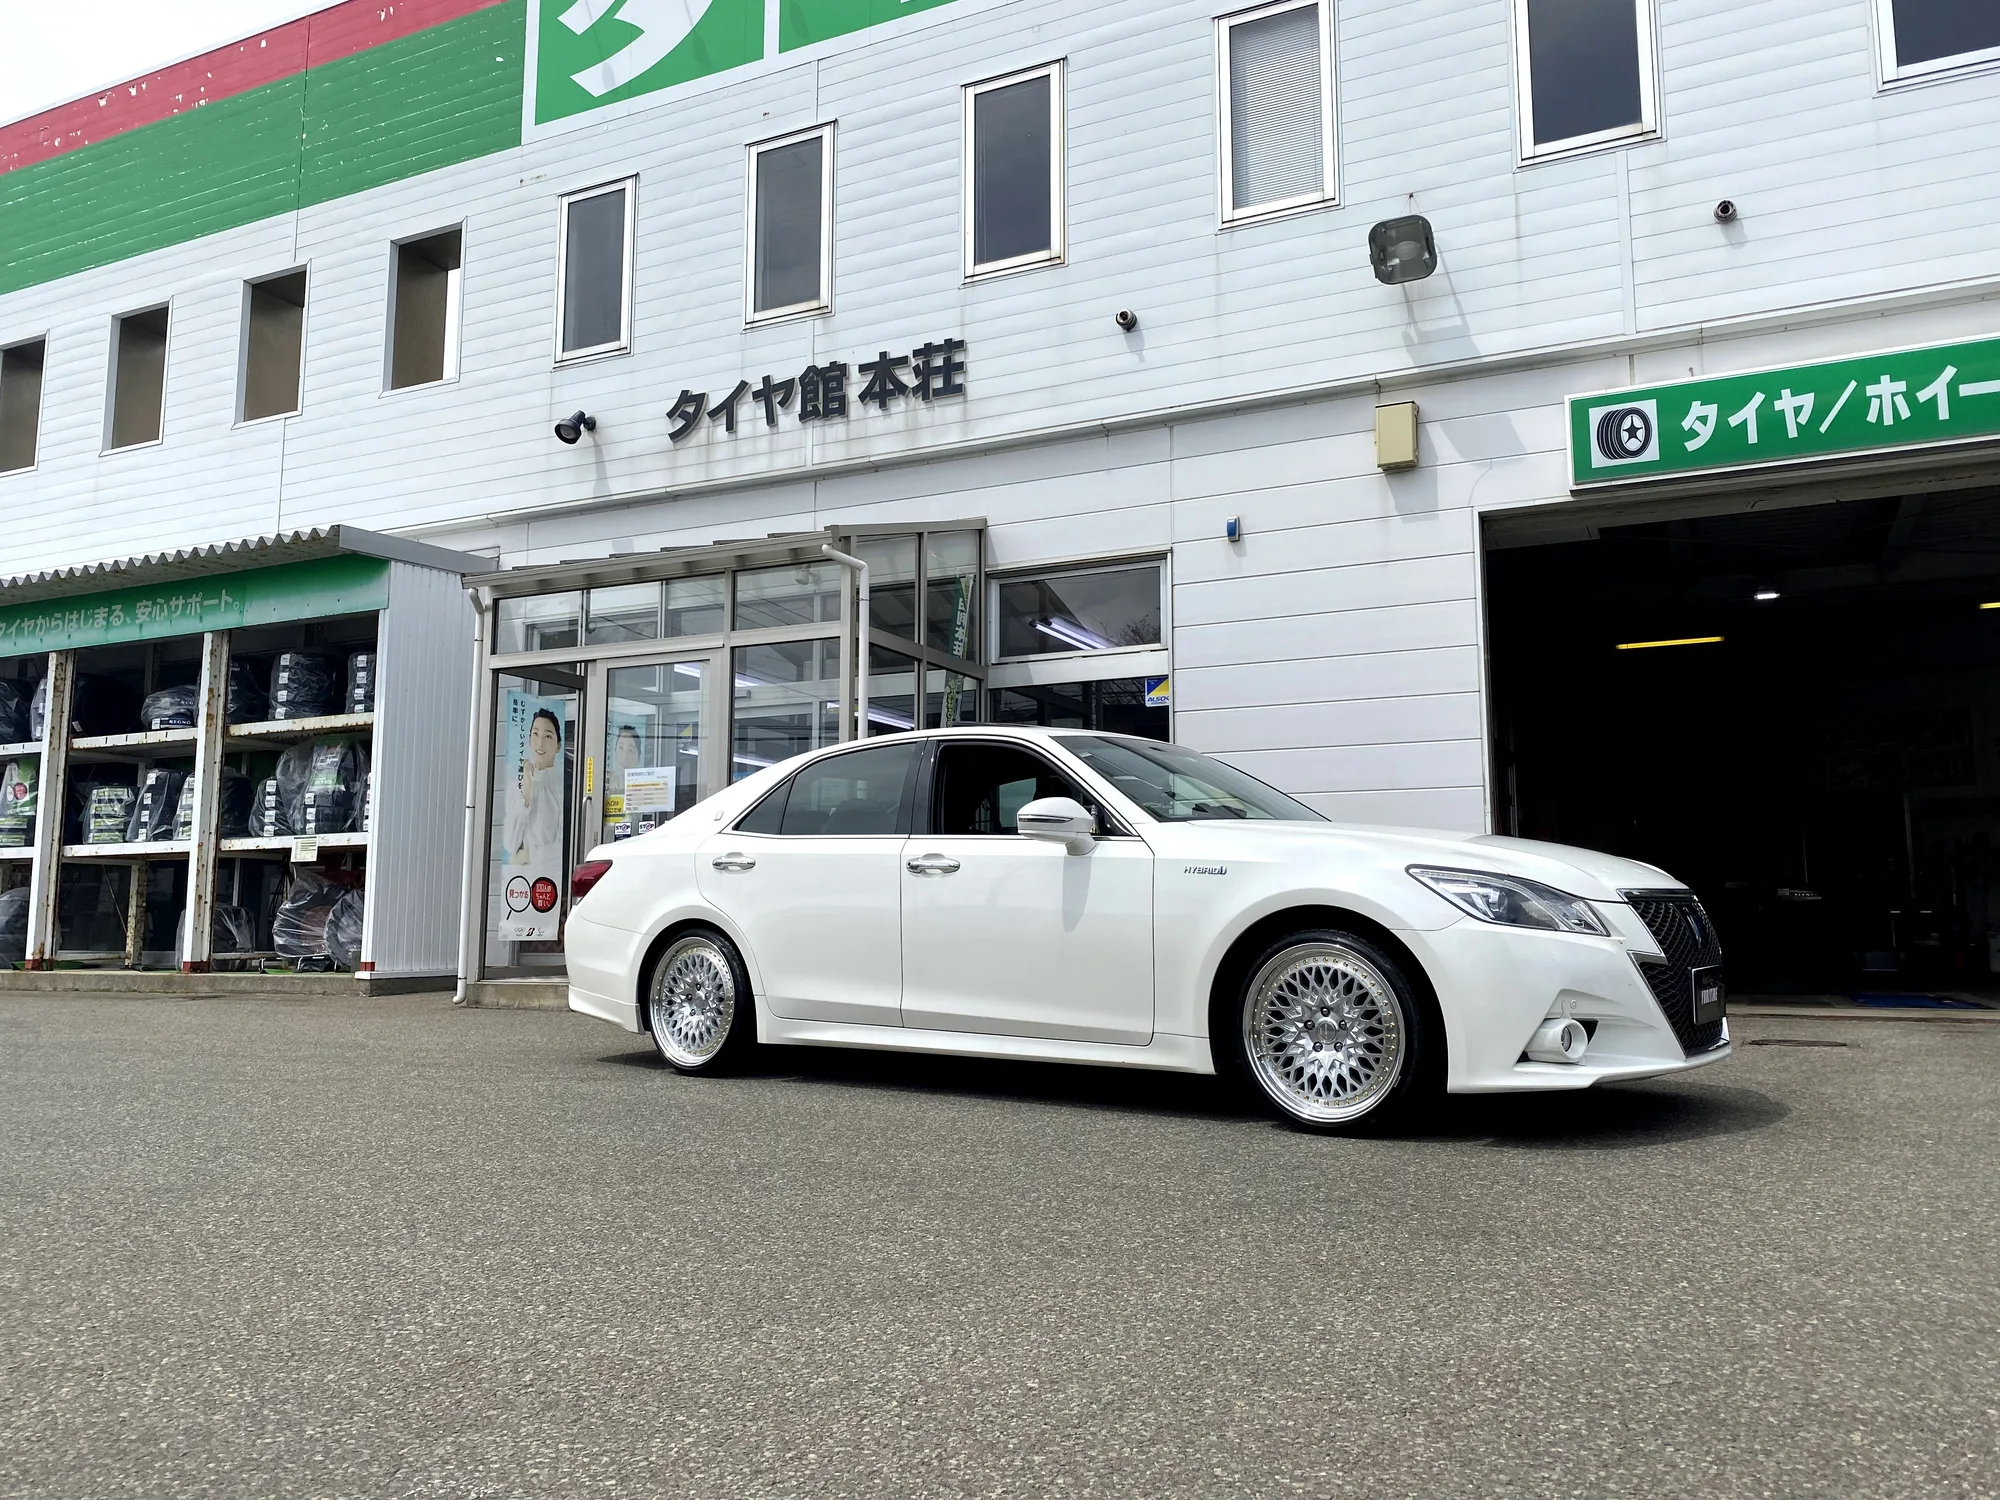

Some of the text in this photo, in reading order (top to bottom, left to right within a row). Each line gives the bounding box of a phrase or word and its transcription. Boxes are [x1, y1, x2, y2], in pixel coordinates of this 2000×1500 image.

[666, 338, 967, 443] タイヤ館 本荘
[1183, 865, 1220, 875] HYBRID
[509, 888, 528, 899] 見つかる
